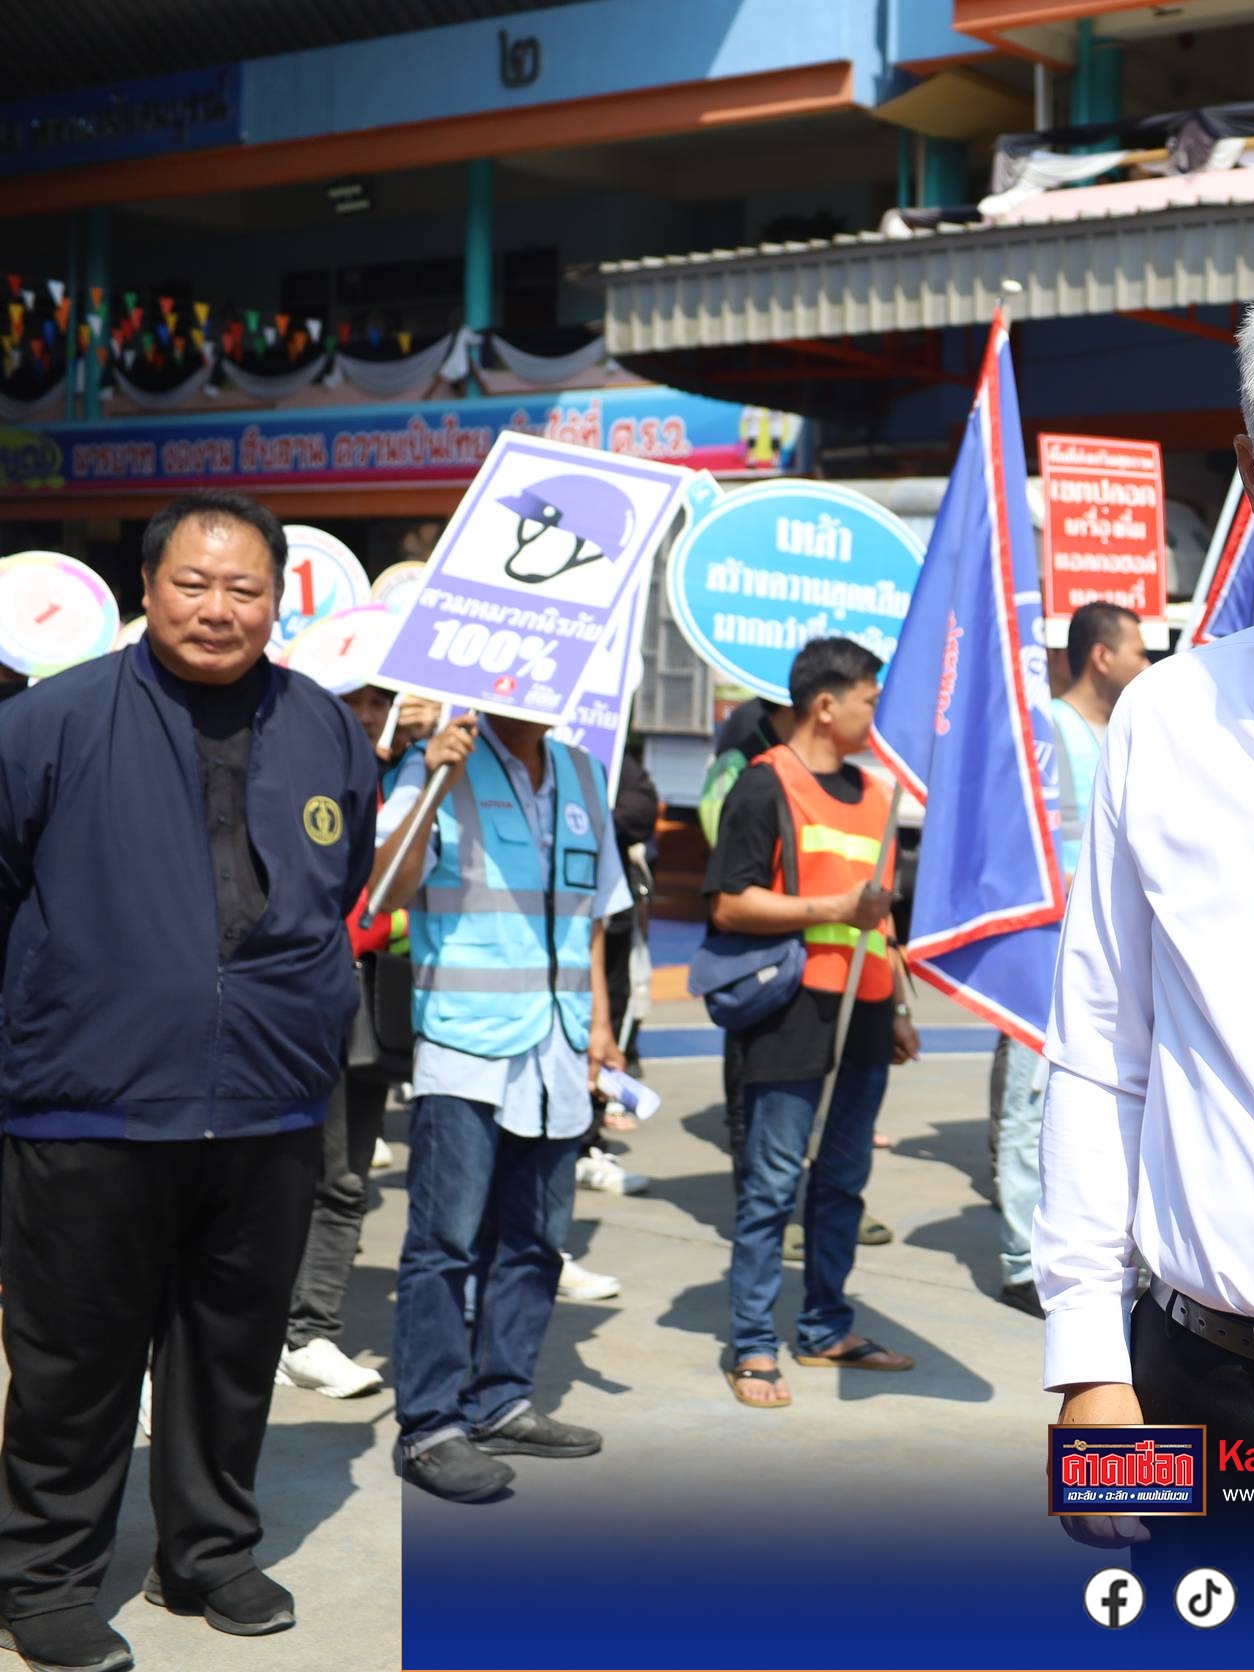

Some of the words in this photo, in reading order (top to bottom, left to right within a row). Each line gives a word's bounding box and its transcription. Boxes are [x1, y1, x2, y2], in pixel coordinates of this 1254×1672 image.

[776, 513, 852, 562] เหล้า
[291, 559, 315, 616] 1
[419, 587, 604, 642] สวมหมวกนิรภัย
[427, 620, 559, 682] 100%
